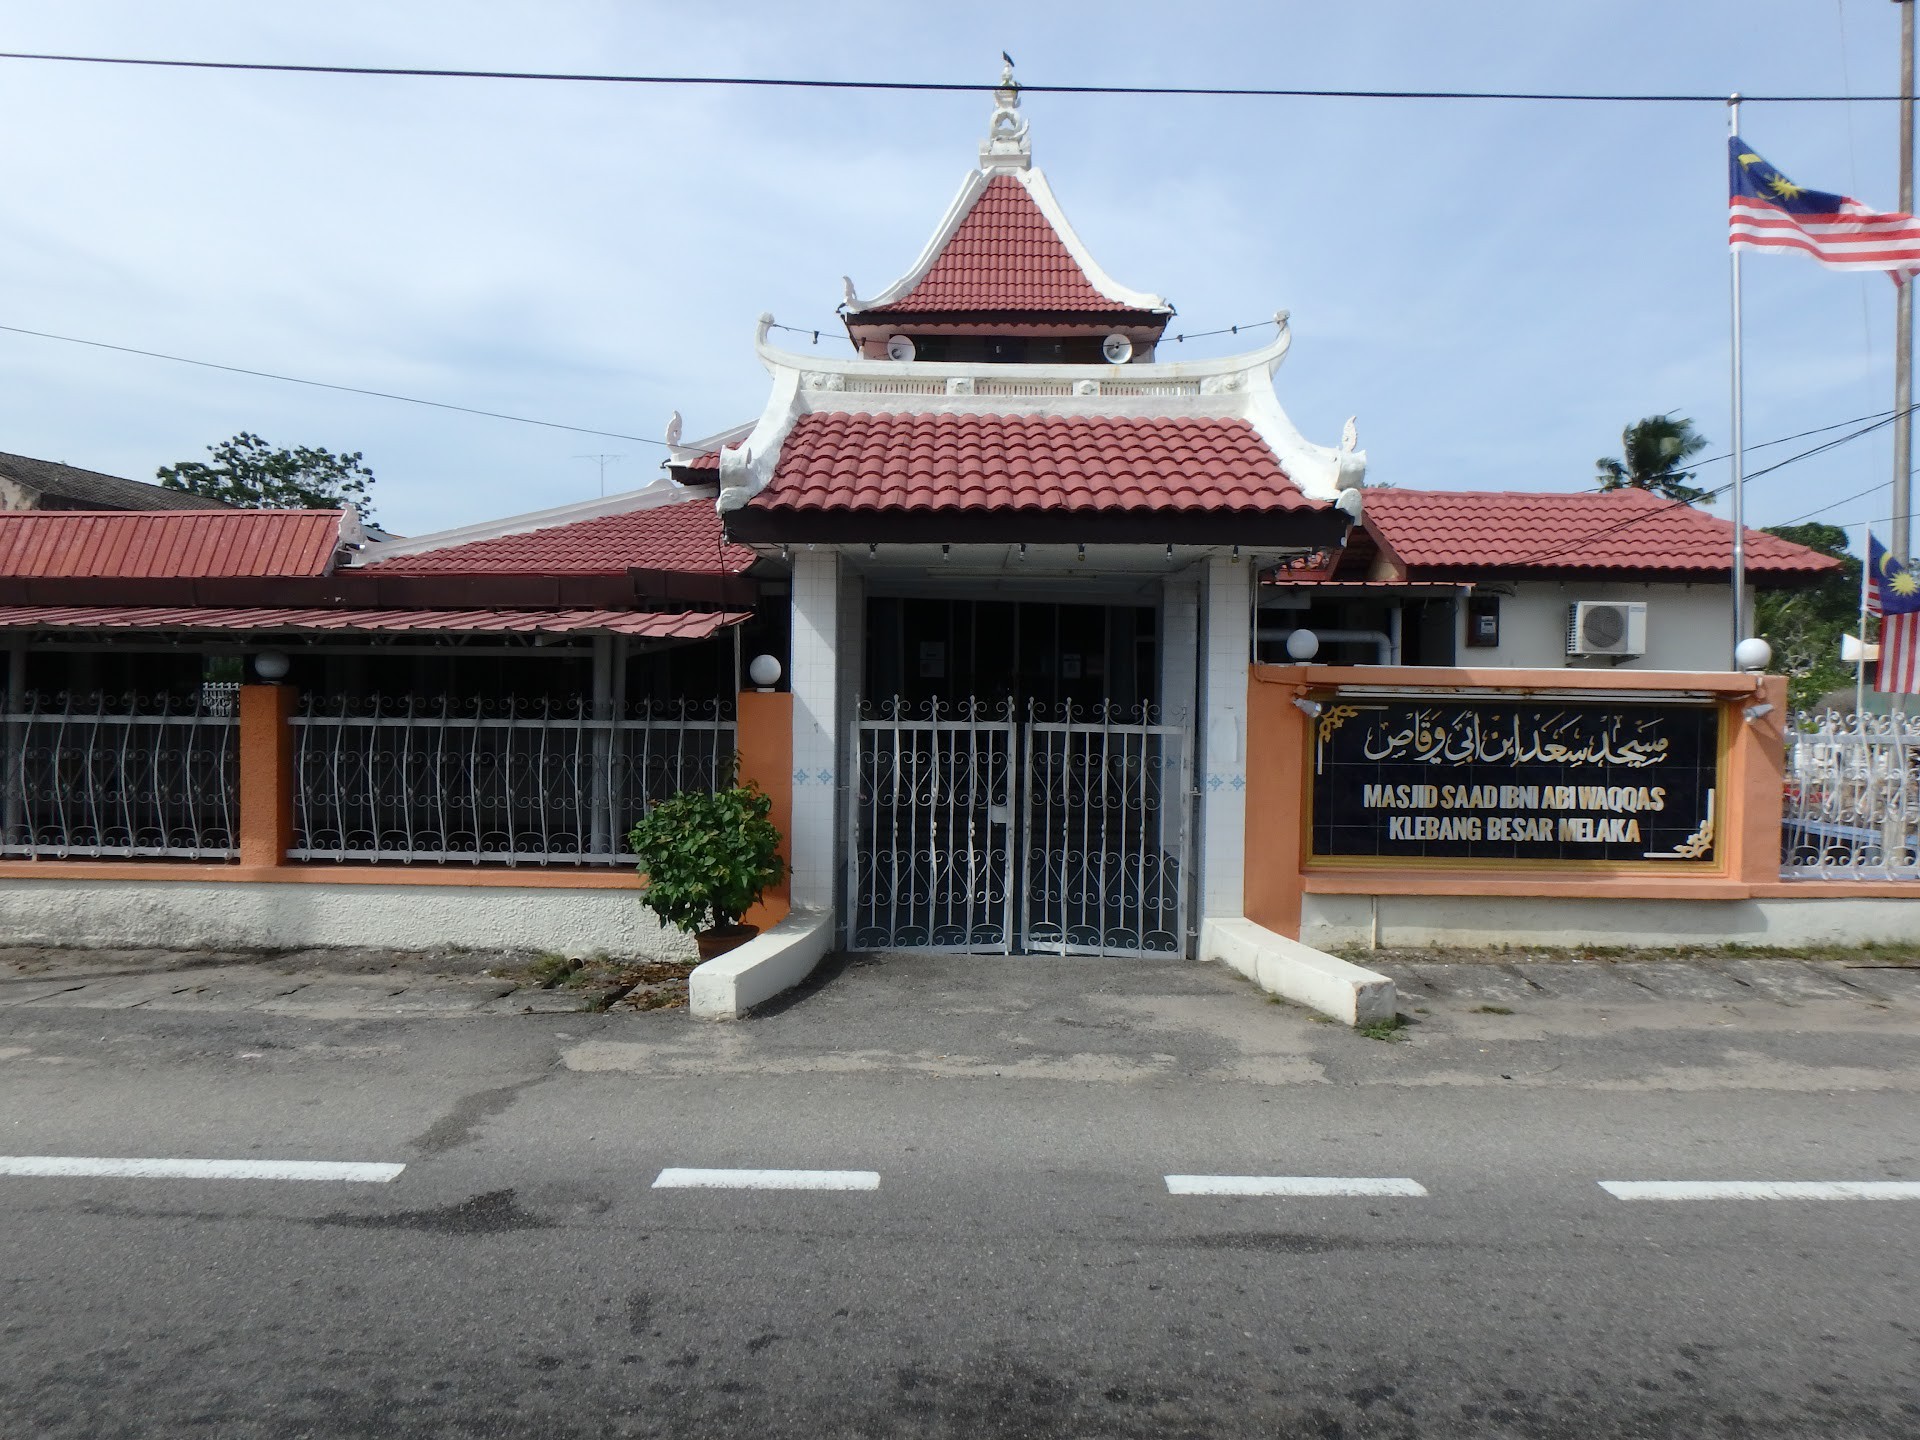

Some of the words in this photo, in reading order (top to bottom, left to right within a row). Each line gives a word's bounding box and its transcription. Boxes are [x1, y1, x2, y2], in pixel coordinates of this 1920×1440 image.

[1363, 784, 1438, 809] MASJID
[1440, 784, 1498, 809] SAAD
[1499, 785, 1540, 810] IBNI
[1541, 785, 1577, 811] ABI
[1577, 786, 1666, 813] WAQQAS
[1389, 816, 1482, 841] KLEBANG
[1486, 817, 1554, 842] BESAR
[1558, 818, 1641, 843] MELAKA
